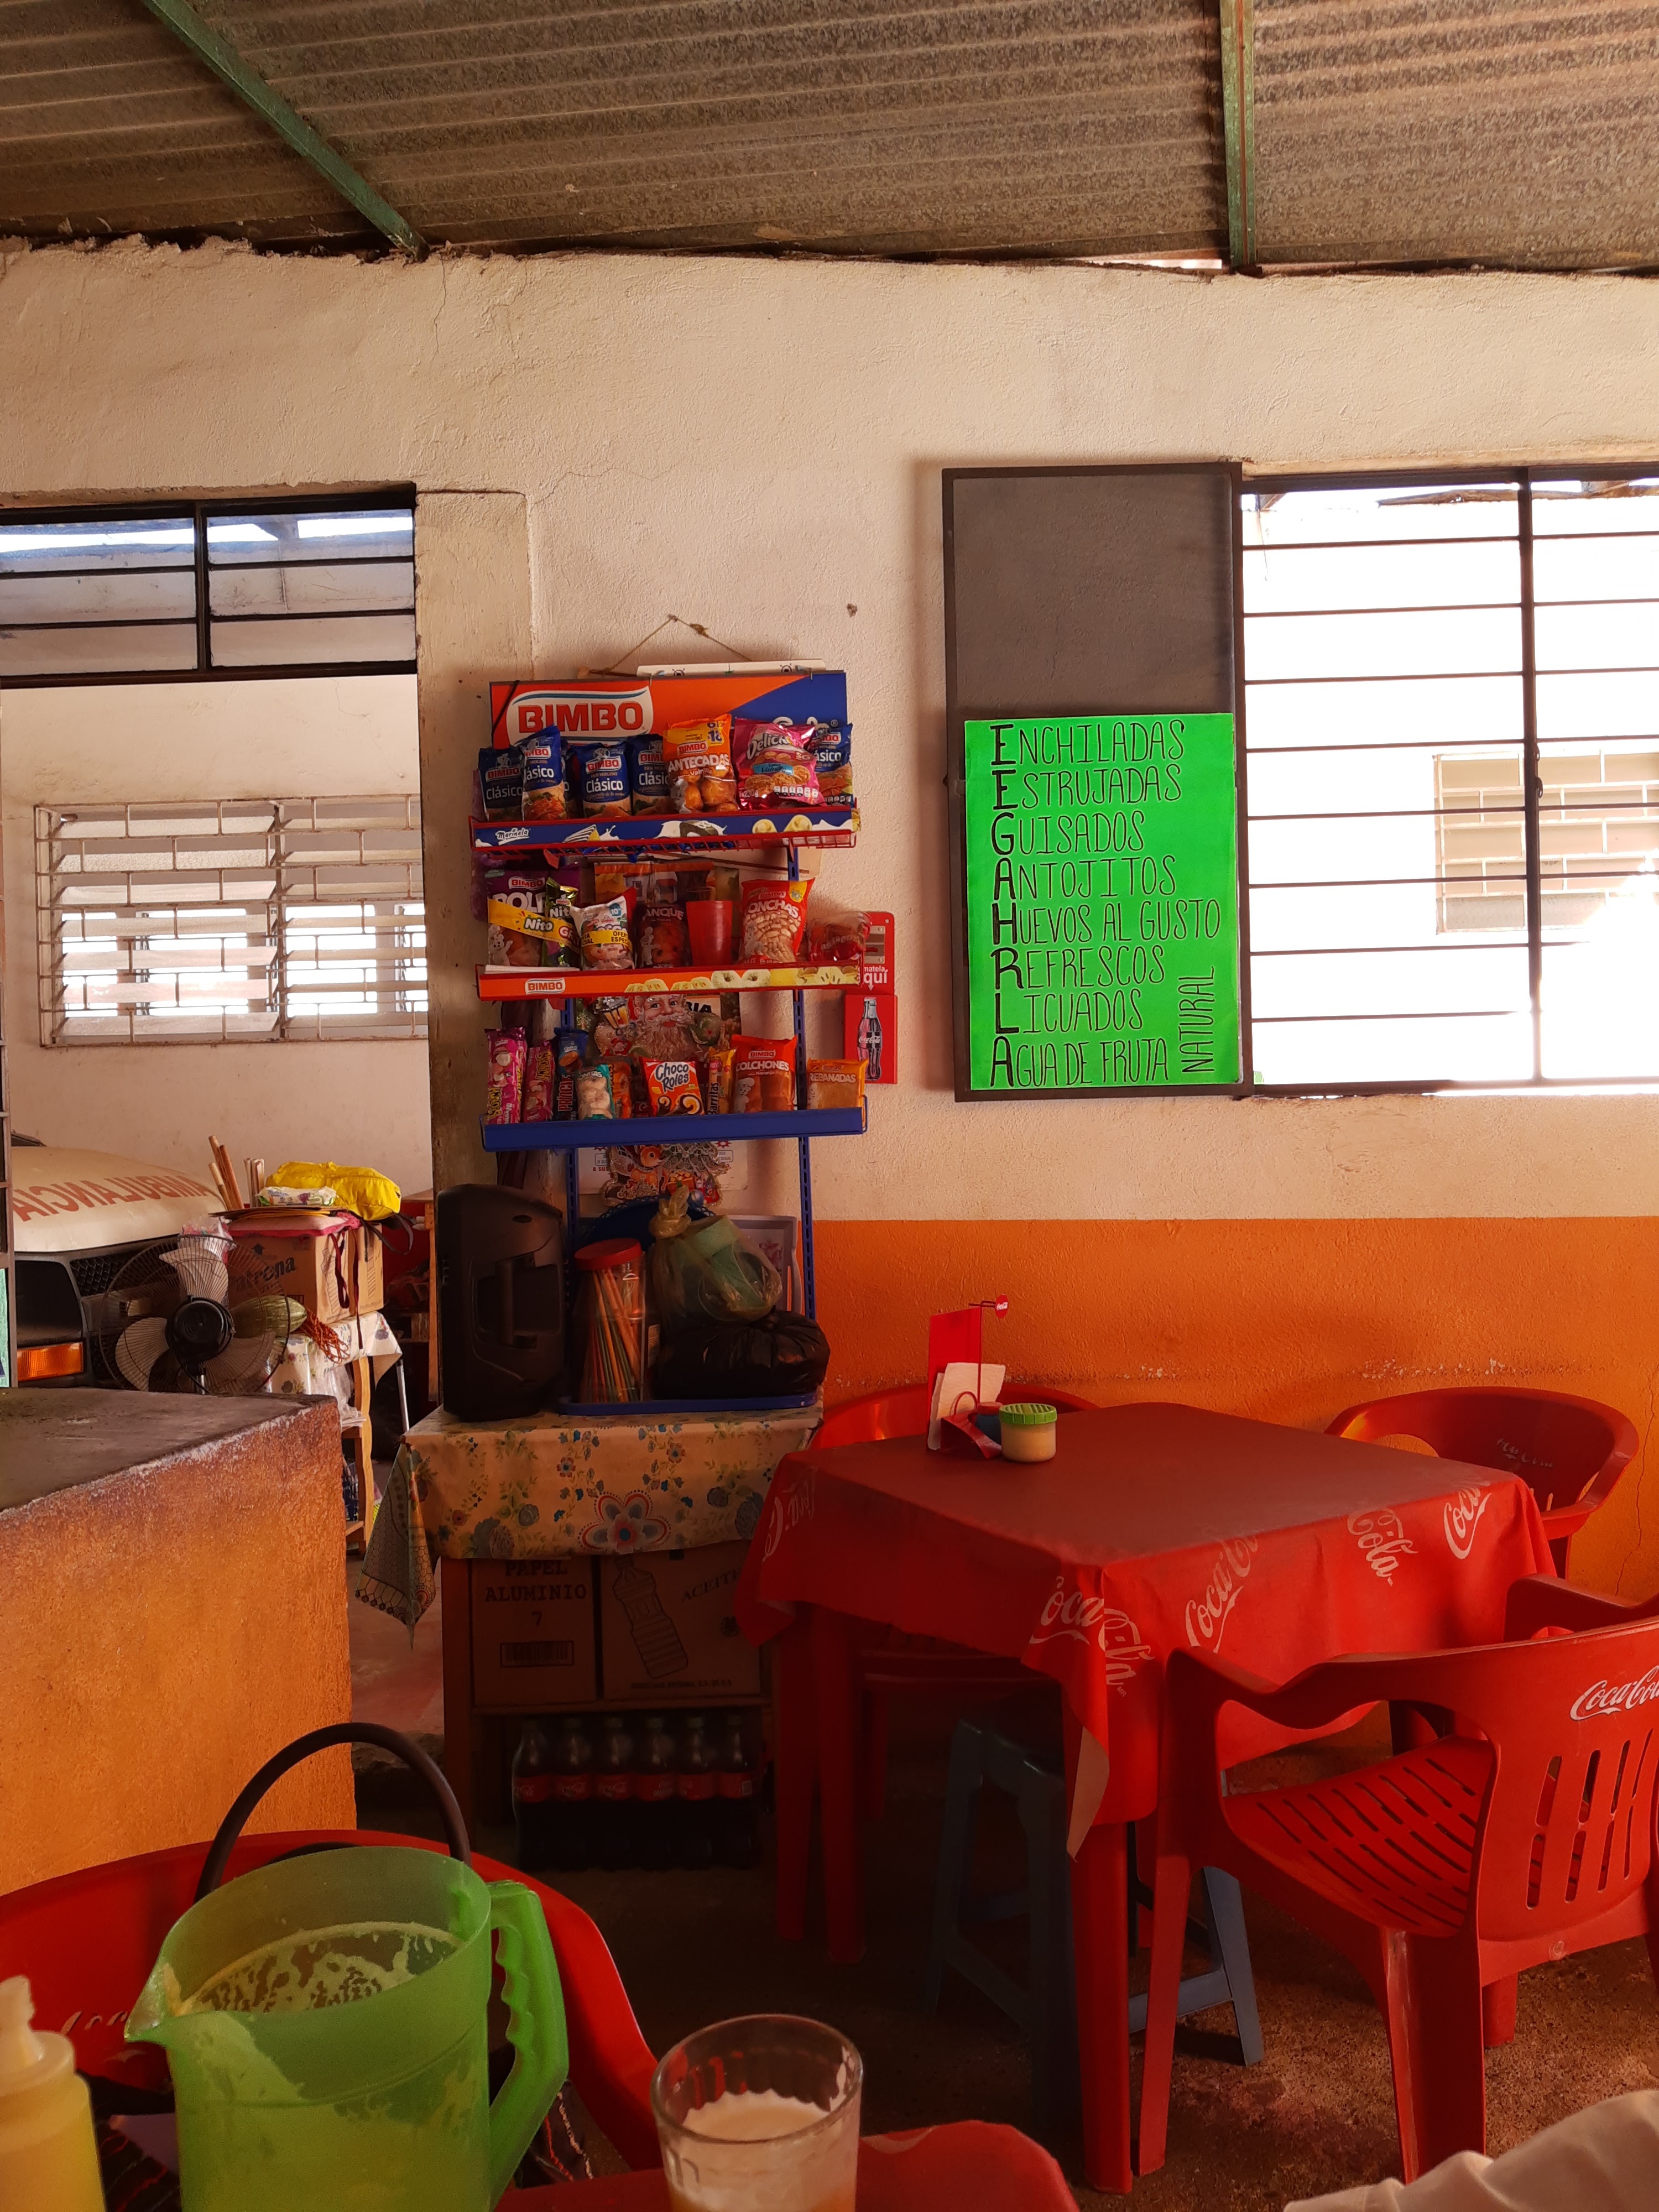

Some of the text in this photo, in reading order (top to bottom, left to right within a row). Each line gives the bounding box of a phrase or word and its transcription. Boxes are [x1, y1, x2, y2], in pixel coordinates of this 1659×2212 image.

[518, 701, 643, 733] BIMBO
[679, 743, 706, 753] BIMBO
[747, 733, 789, 760] Delici
[990, 719, 1185, 766] ENCHILADAS
[525, 748, 549, 757] MBO
[640, 753, 664, 762] BIM
[813, 749, 842, 762] ásico
[587, 759, 619, 771] BIMBO
[668, 754, 731, 773] ANTECADAS
[487, 767, 519, 779] BIMBO
[526, 765, 554, 781] ásico
[639, 771, 668, 786] Clásic
[486, 785, 523, 800] Clásico
[586, 778, 623, 793] Clásico
[992, 764, 1181, 810] ESTRUJADAS
[497, 828, 528, 839] Marinela
[992, 810, 1145, 855] GUISADOS
[994, 855, 1176, 900] ANTOJITOS
[493, 891, 546, 913] ROL
[748, 899, 799, 919] ONCHAS
[550, 906, 570, 918] Nit
[643, 908, 684, 921] ANQUE
[525, 918, 553, 931] Nito
[992, 899, 1220, 945] HUEVOS AL GUSTO
[990, 945, 1165, 990] REFRESCOS
[528, 981, 563, 991] BIMBO
[995, 989, 1142, 1034] LICUADOS
[1179, 966, 1215, 1073] NATURAL
[735, 1060, 789, 1072] COLCHONES
[990, 1036, 1168, 1087] AGUA DE FRUTA
[655, 1063, 689, 1081] Choco
[809, 1072, 857, 1083] REBANADAS
[662, 1073, 689, 1093] Roles
[708, 1082, 718, 1115] Barritas
[505, 1560, 568, 1576] PAPEL
[484, 1584, 586, 1601] ALUMINIO
[532, 1611, 542, 1626] 7
[1570, 1665, 1659, 1721] Coca-Co
